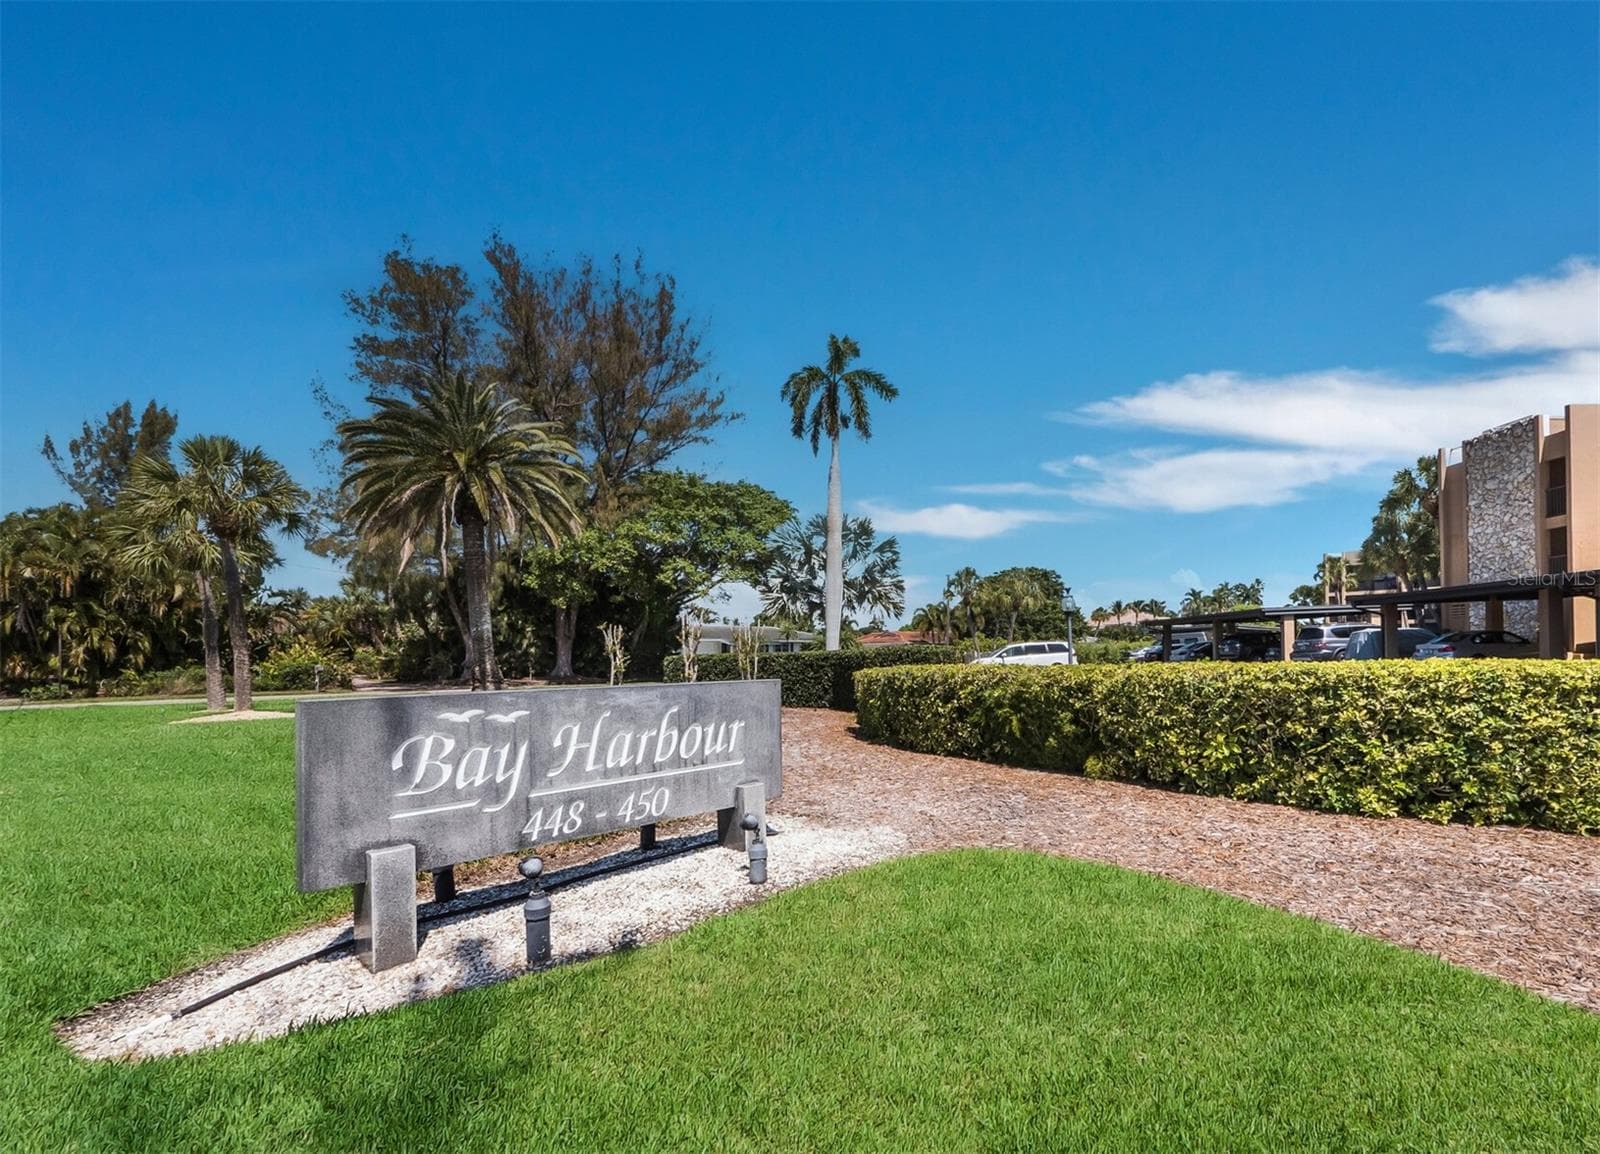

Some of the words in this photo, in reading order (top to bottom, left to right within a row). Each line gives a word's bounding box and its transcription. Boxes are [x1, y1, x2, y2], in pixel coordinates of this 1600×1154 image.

[391, 732, 529, 813] Bay
[547, 706, 745, 777] Harbour
[522, 801, 584, 841] 448
[617, 786, 669, 822] 450
